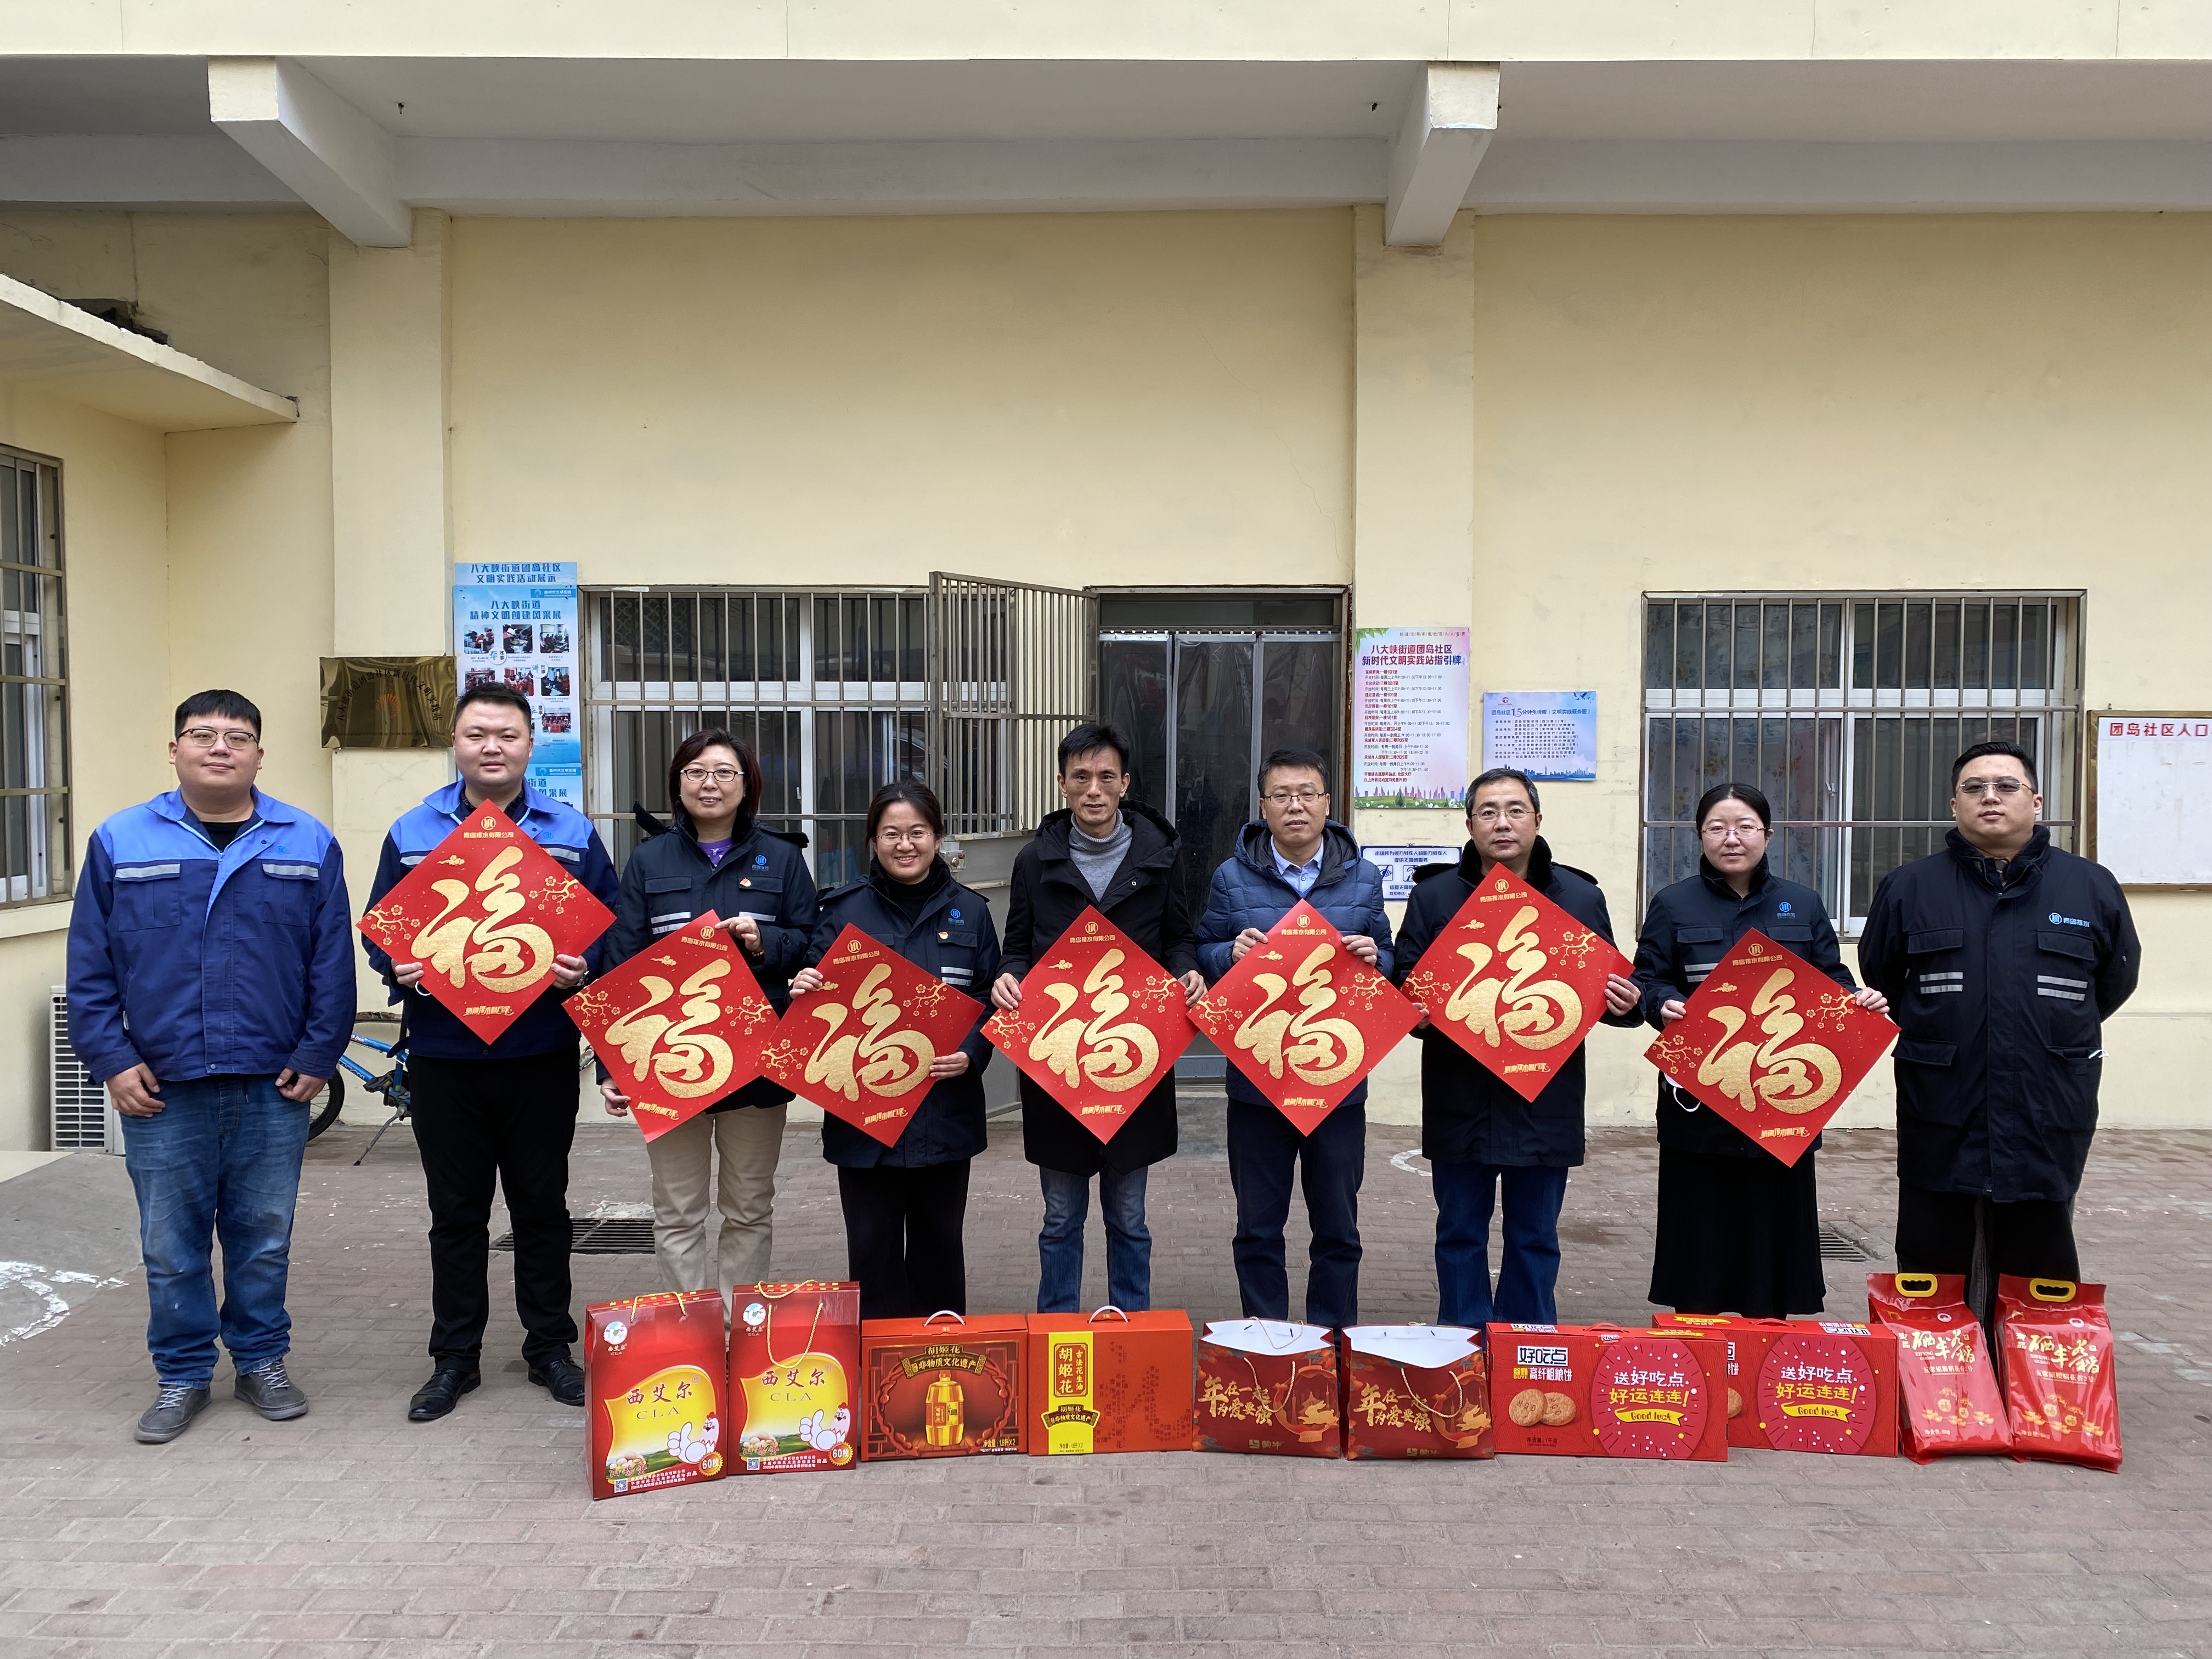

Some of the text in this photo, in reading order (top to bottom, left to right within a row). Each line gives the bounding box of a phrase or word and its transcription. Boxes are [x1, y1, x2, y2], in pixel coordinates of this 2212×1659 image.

[471, 563, 561, 573] 八大峡街道团岛社区
[476, 574, 556, 583] 文明实践活动展示
[491, 600, 541, 609] 八大峡街道
[470, 611, 561, 619] 精神文明创建风采展
[1371, 644, 1452, 654] 八大峡街道团岛社区
[1362, 655, 1462, 665] 新时代文明实践站指引牌
[2109, 723, 2212, 737] 团岛社区人口
[410, 845, 555, 994] 福
[1445, 905, 1583, 1051] 福
[1028, 948, 1159, 1092] 福
[1234, 943, 1364, 1086] 福
[604, 958, 733, 1099] 福
[804, 963, 935, 1102] 福
[1697, 967, 1842, 1114] 福
[1519, 1347, 1566, 1365] 好吃点
[761, 1368, 825, 1388] 西艾尔
[1058, 1348, 1073, 1394] 胡姬花
[1530, 1367, 1572, 1382] 高纤粗粮饼
[1614, 1370, 1685, 1387] 送好吃点
[1781, 1365, 1853, 1384] 送好吃点
[627, 1381, 692, 1404] 西艾尔
[770, 1392, 811, 1402] CLA
[1610, 1388, 1690, 1408] 好运连连!
[1775, 1382, 1858, 1404] 好运连连!
[636, 1406, 680, 1420] CLA
[1630, 1412, 1672, 1422] Good luck
[1798, 1407, 1839, 1417] Good luck
[832, 1448, 849, 1458] 60枚
[702, 1458, 719, 1469] 60枚
